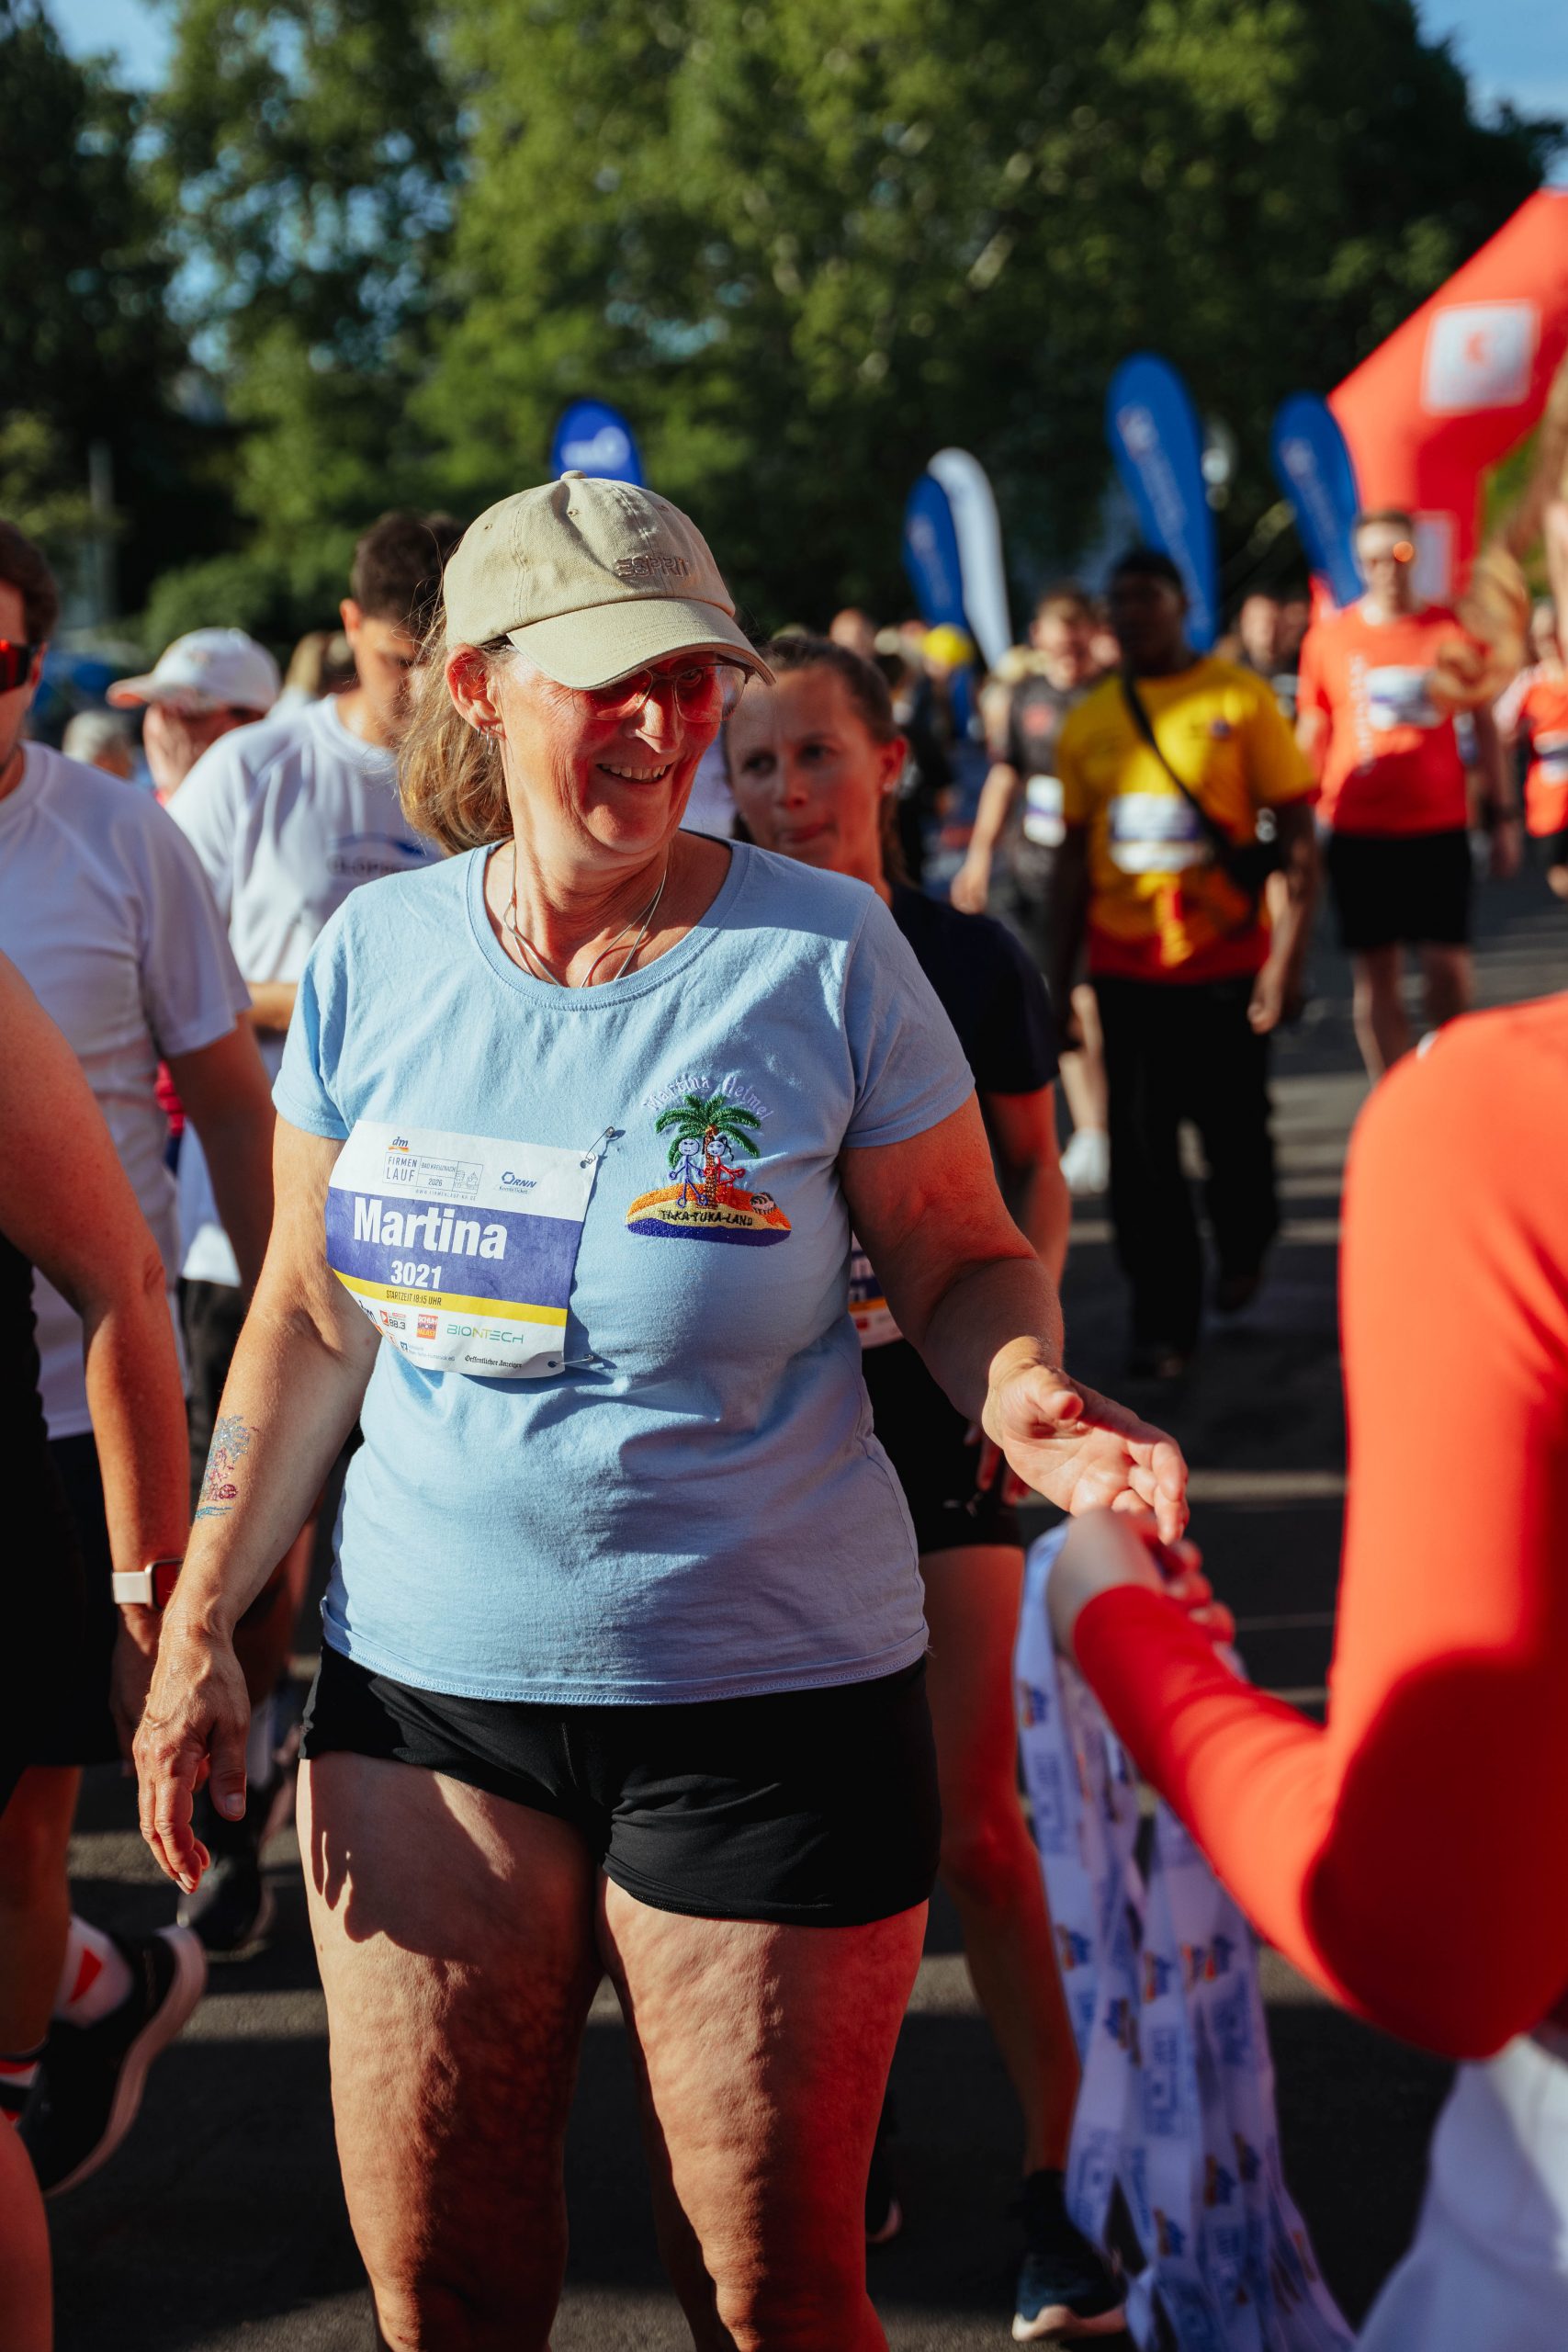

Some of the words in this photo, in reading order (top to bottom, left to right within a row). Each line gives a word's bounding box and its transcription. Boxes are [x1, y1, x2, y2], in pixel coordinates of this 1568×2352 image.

[615, 555, 691, 579] ESPRIT
[391, 1136, 409, 1148] dm
[388, 1156, 418, 1168] FIRMEN
[386, 1167, 416, 1182] LAUF
[428, 1178, 443, 1187] 2026
[354, 1197, 508, 1260] Martina
[390, 1260, 442, 1289] 3021
[386, 1289, 412, 1302] STARTZEIT
[413, 1292, 427, 1304] 18:15
[428, 1296, 442, 1306] UHR
[446, 1323, 524, 1344] BIONTECH
